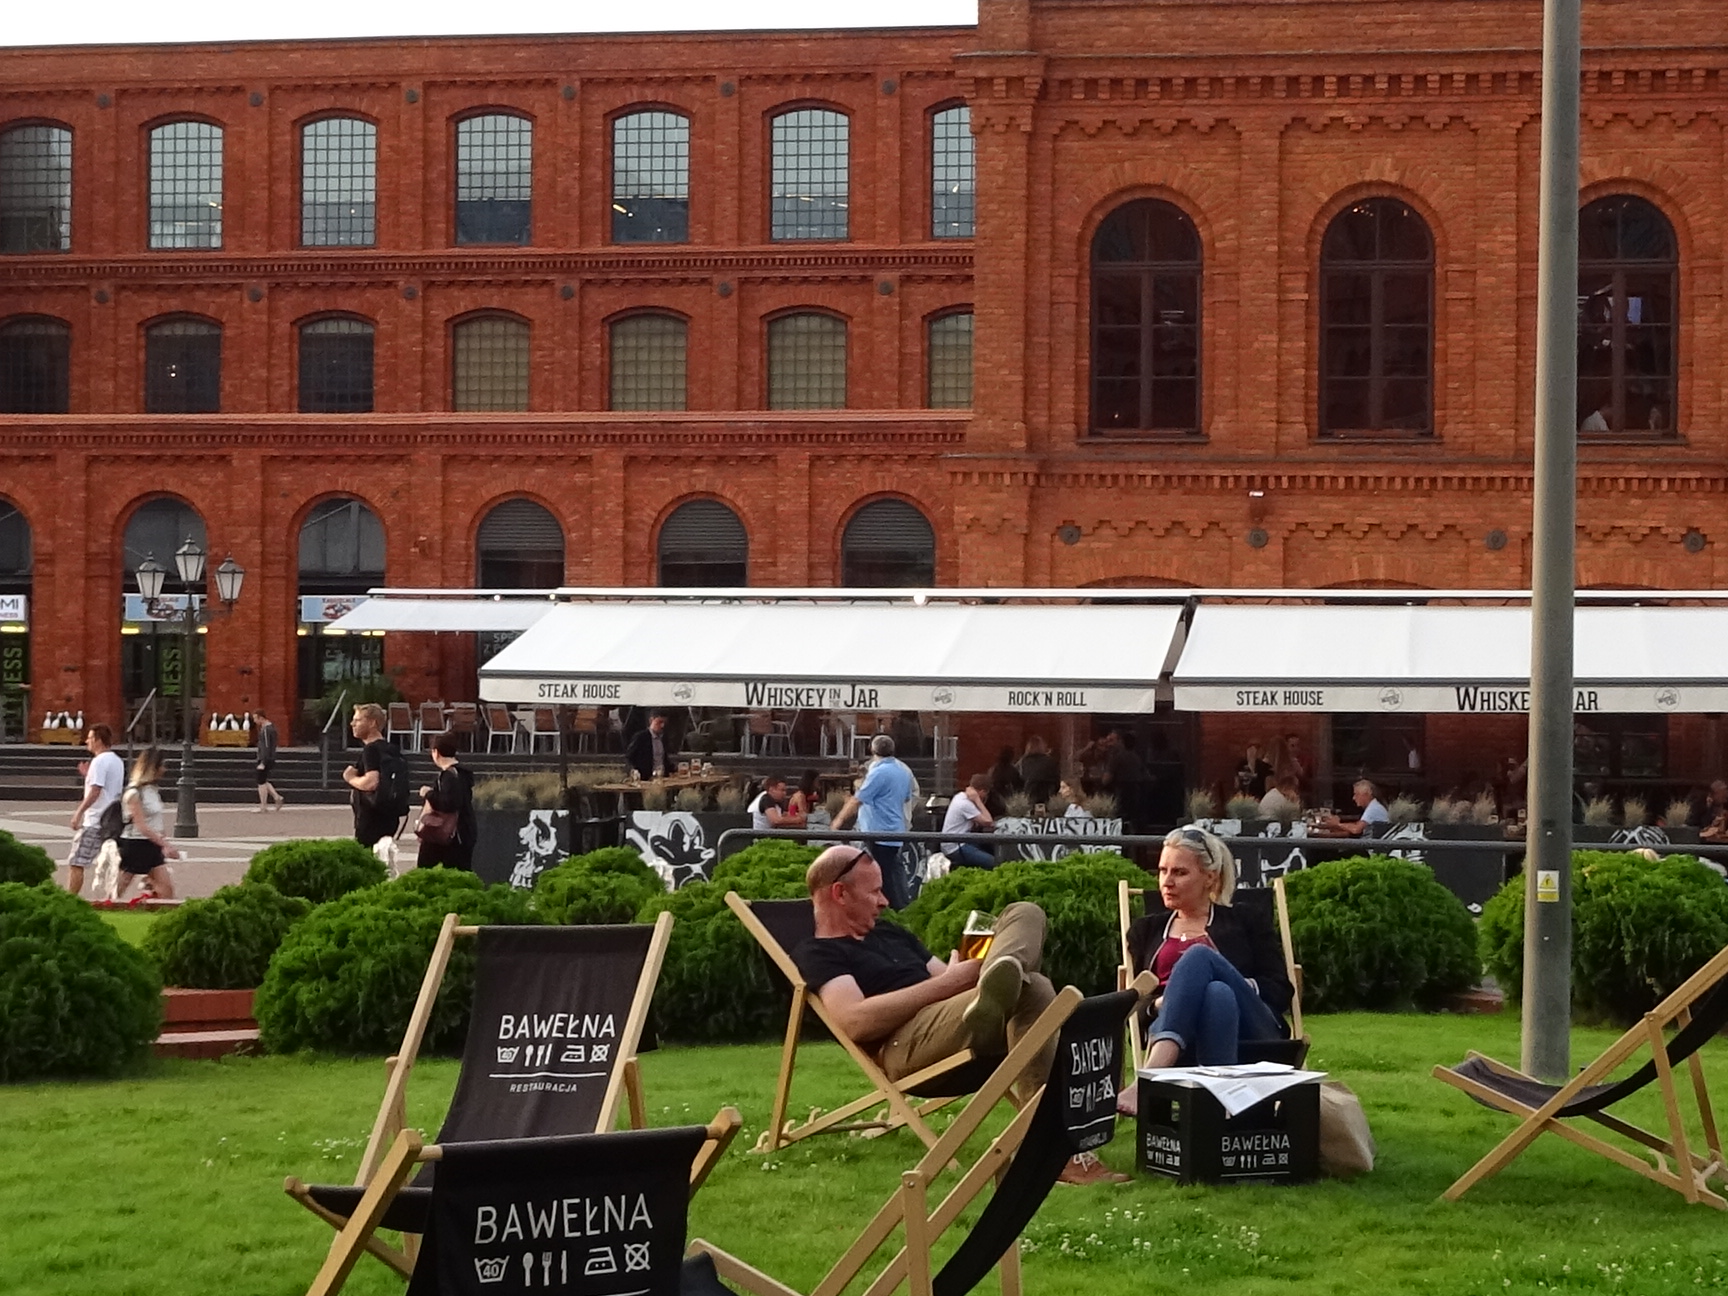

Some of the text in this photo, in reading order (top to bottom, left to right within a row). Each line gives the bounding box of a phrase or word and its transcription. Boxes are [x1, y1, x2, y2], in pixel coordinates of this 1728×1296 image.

[538, 683, 621, 699] STEAK HOUSE
[744, 682, 826, 707] WHISKEY
[843, 684, 879, 708] JAR
[1056, 691, 1087, 707] ROLL
[1236, 690, 1324, 706] STEAK HOUSE
[1455, 686, 1599, 711] WHISKE AR
[499, 1013, 615, 1040] BAWEŁNA
[509, 1082, 577, 1093] RESTAURACJA
[1222, 1134, 1290, 1152] BAWEŁNA
[474, 1193, 653, 1245] BAWEŁNA
[483, 1264, 500, 1278] 40
